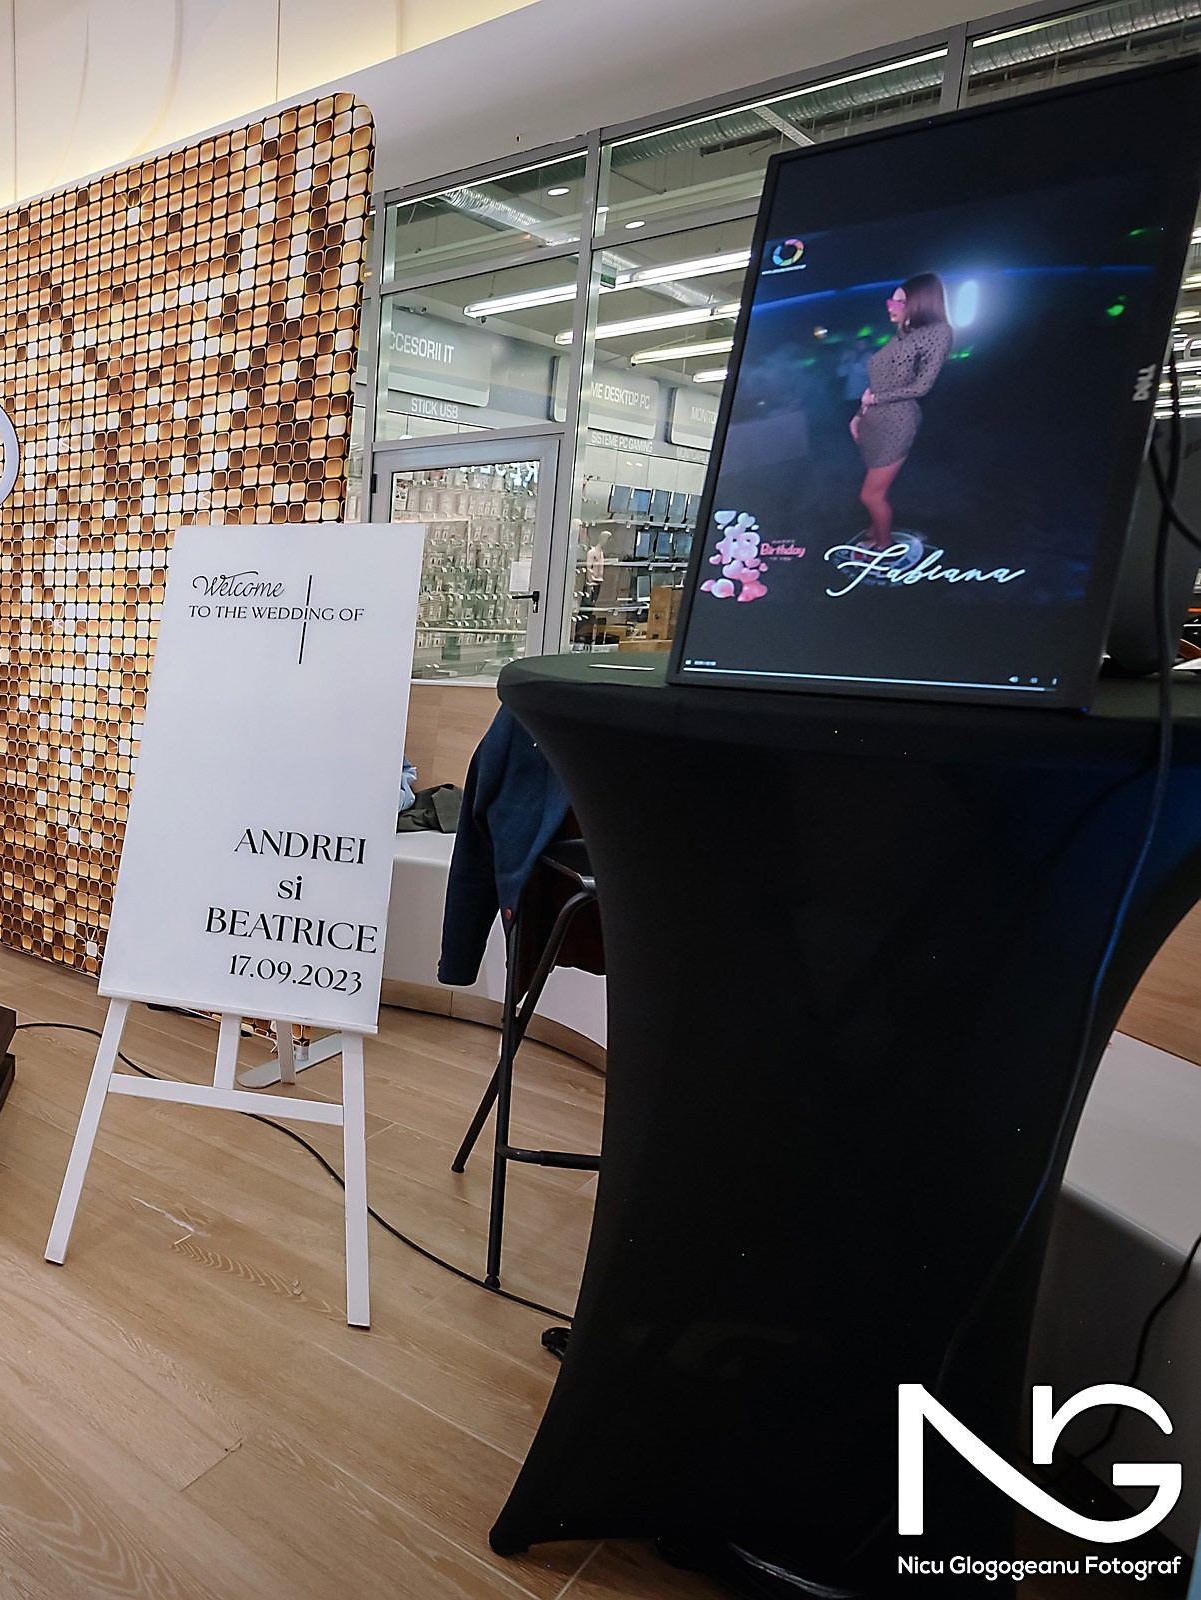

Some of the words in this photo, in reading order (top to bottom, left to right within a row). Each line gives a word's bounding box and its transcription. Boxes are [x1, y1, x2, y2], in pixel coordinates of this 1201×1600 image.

[443, 344, 455, 364] IT
[411, 397, 439, 416] STICK
[439, 403, 459, 419] USB
[604, 384, 640, 407] DESKTOP
[639, 393, 651, 410] PC
[760, 542, 806, 558] Birthday
[823, 543, 1026, 597] Fabiana
[192, 570, 285, 598] Welcome
[188, 605, 211, 619] TO
[215, 605, 248, 619] THE
[251, 606, 335, 621] WEDDING
[338, 608, 365, 622] OF
[233, 828, 367, 865] ANDREI
[277, 875, 303, 901] si
[205, 906, 378, 954] BEATRICE
[229, 954, 363, 996] 17.09.2023
